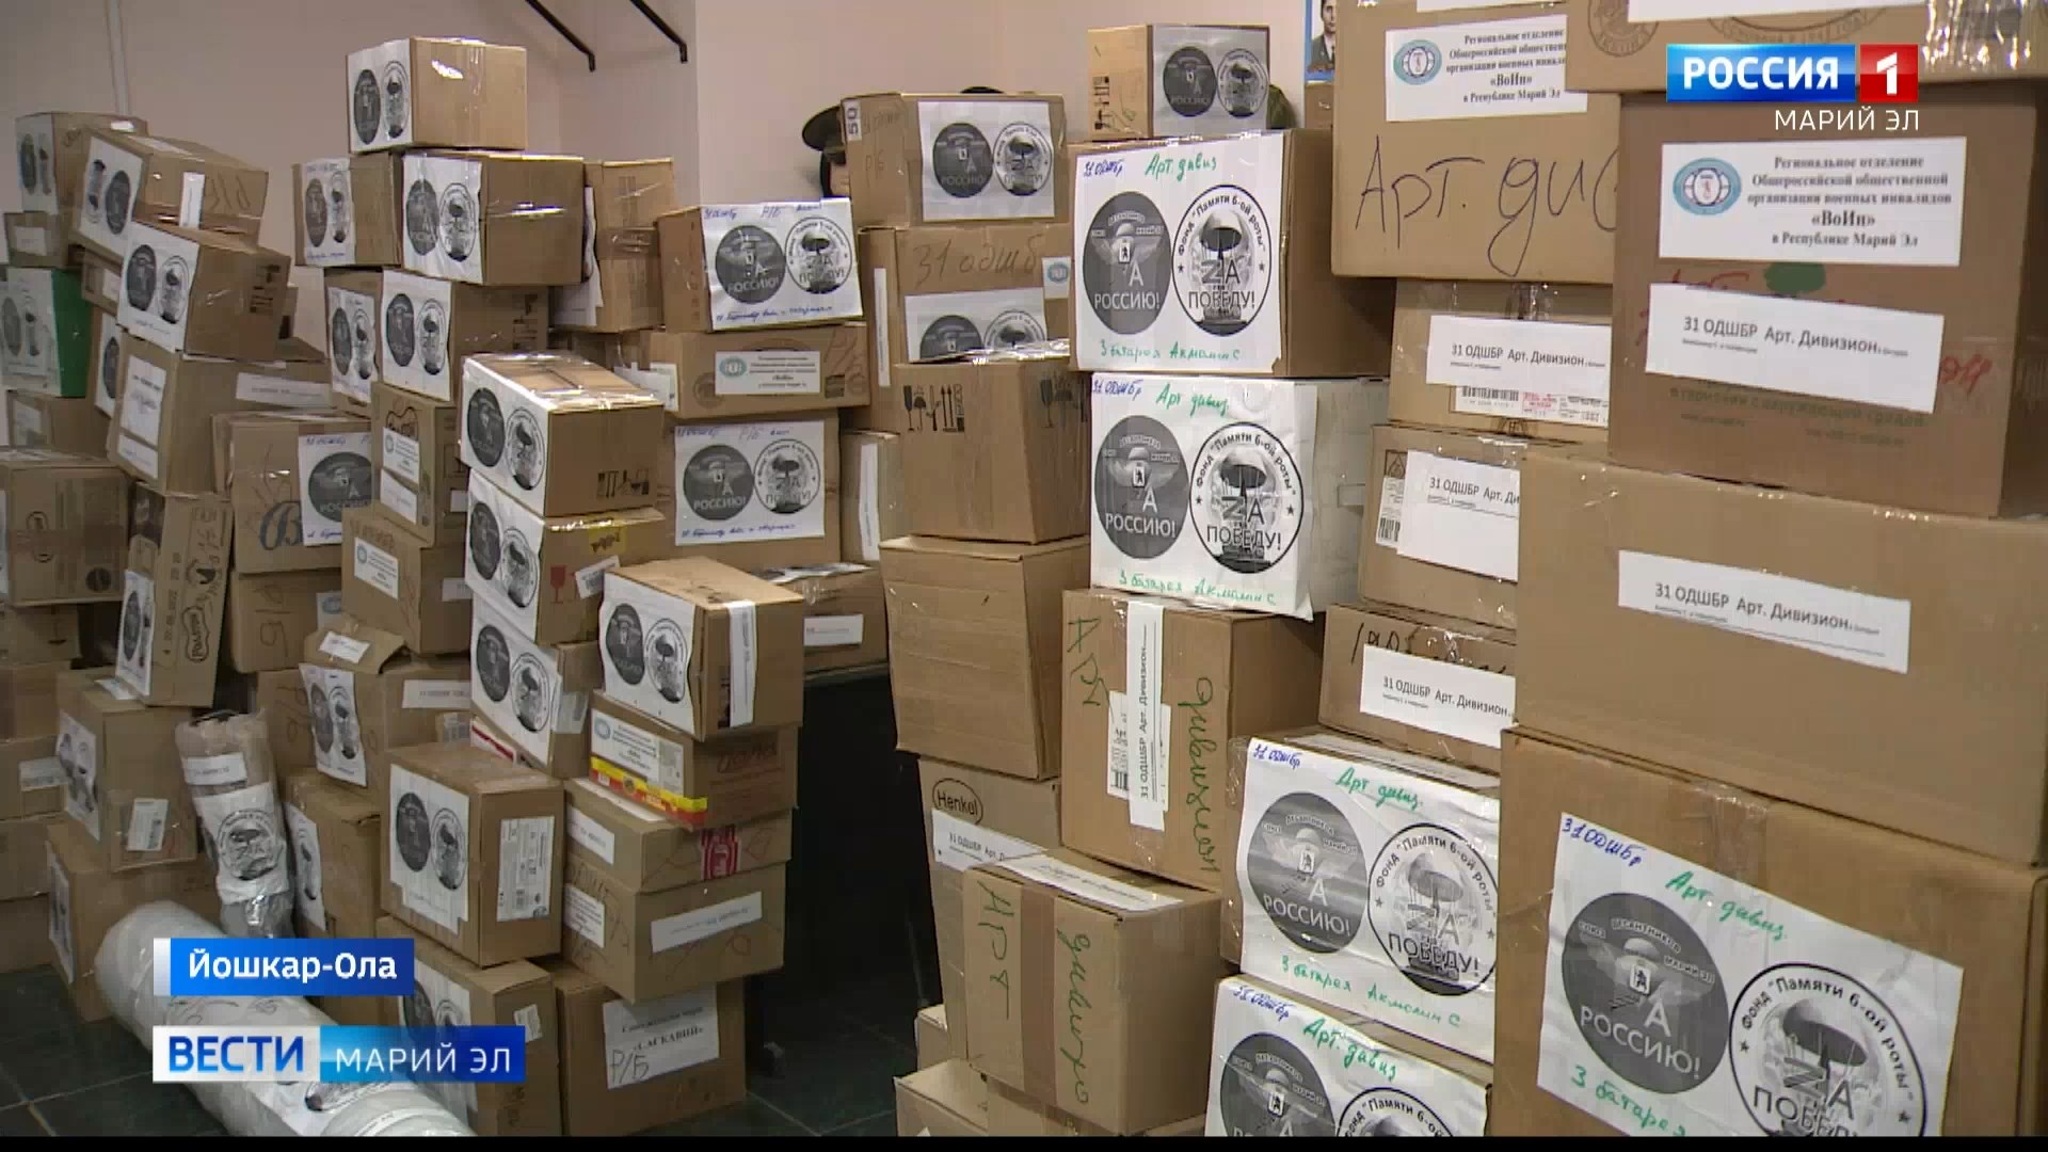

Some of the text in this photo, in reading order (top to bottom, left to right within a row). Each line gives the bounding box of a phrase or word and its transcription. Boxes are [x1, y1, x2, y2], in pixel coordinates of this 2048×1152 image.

[1811, 210, 1876, 228] «ВоИн»
[1781, 231, 1849, 248] Республике
[1853, 231, 1897, 247] Марий
[1094, 291, 1161, 310] РОССИЮ!
[1683, 316, 1699, 332] 31
[1703, 318, 1758, 338] ОДШБР
[1764, 325, 1796, 346] Арт.
[1451, 344, 1463, 356] 31
[1465, 345, 1503, 360] ОДШБР
[1429, 477, 1440, 489] 31
[1443, 479, 1479, 496] ОДШБР
[1105, 512, 1176, 539] РОССИЮ!
[1206, 523, 1282, 551] ПОБЕДУ!
[1655, 583, 1671, 600] 31
[1675, 586, 1729, 609] ОДШБР
[1736, 597, 1768, 618] Арт.
[1383, 674, 1395, 690] 31
[1395, 677, 1431, 699] ОДШБР
[936, 788, 978, 816] Henkel
[1376, 852, 1400, 888] Фонд
[1263, 878, 1351, 937] А РОССИЮ!
[1388, 931, 1480, 978] ПОБЕДУ!
[1741, 990, 1772, 1030] Фонд
[1848, 992, 1888, 1034] 6-ой
[1579, 998, 1700, 1080] А РОССИЮ!
